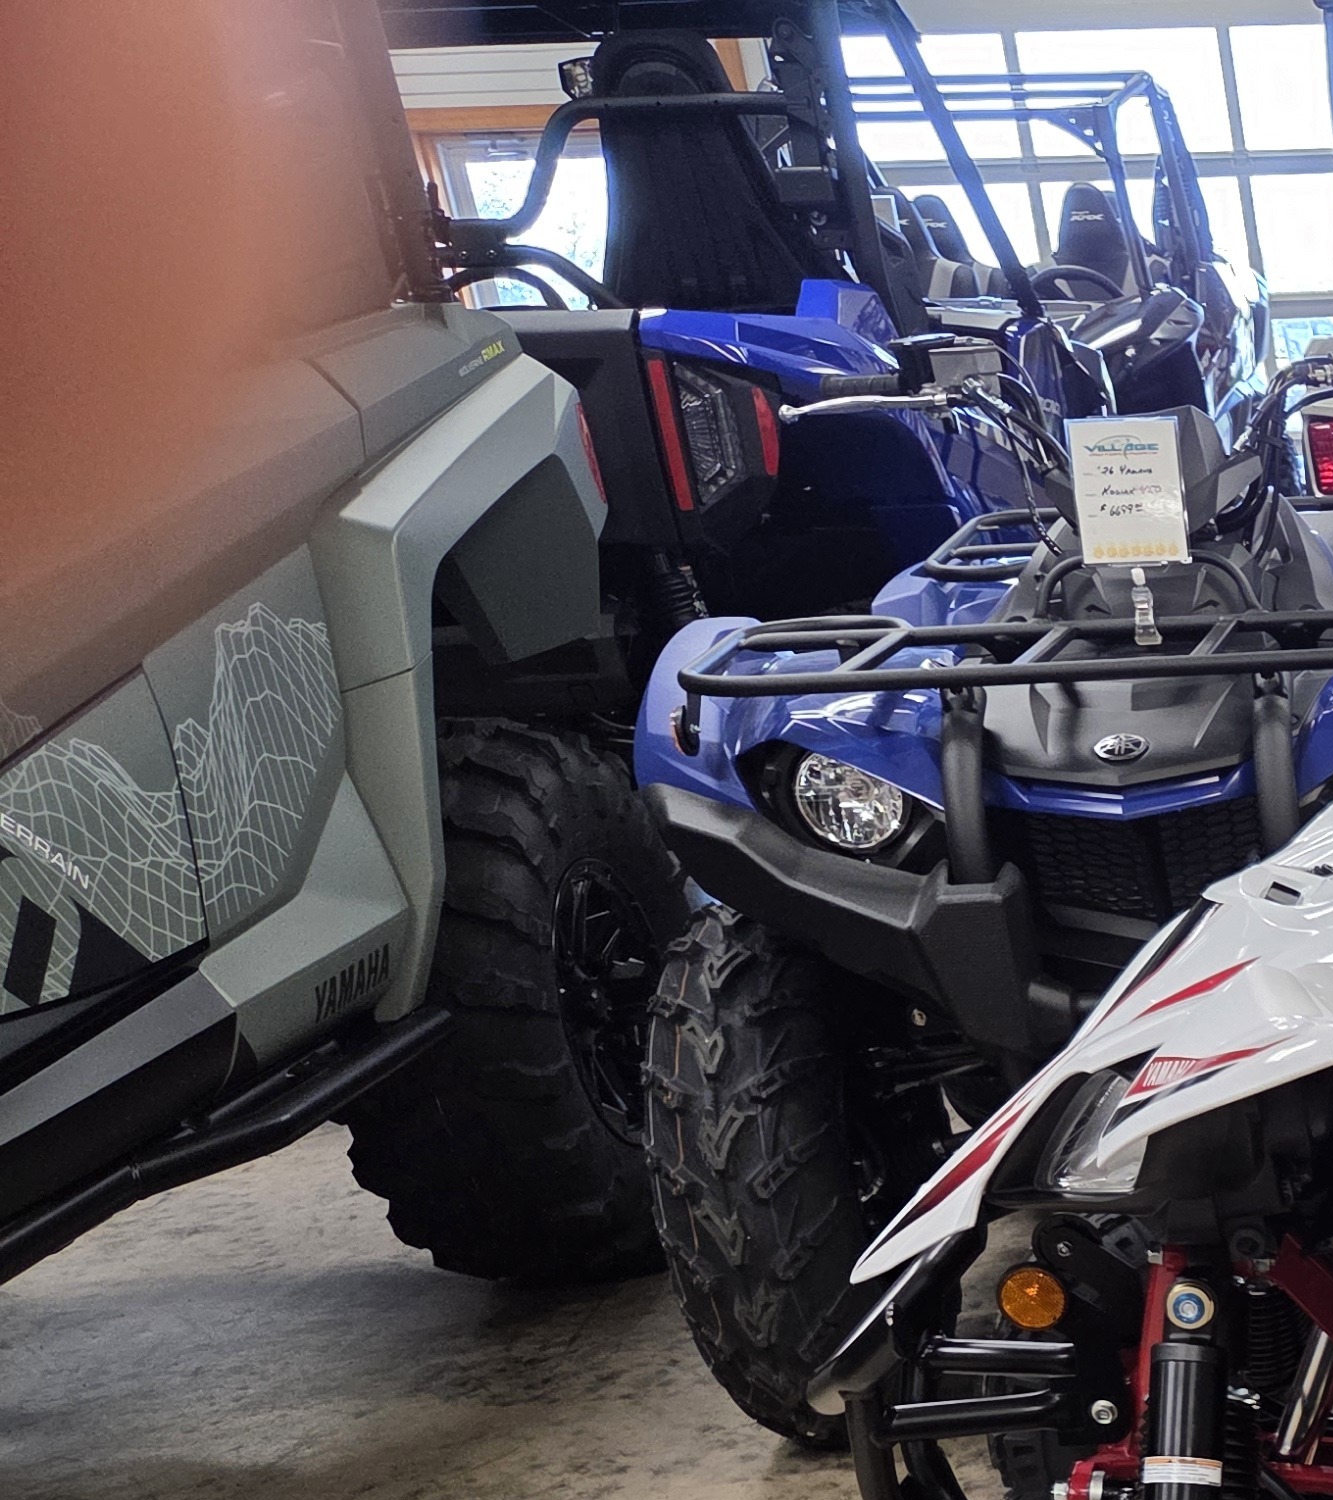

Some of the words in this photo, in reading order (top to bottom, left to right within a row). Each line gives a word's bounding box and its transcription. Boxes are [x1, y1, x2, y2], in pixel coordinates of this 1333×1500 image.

[1083, 443, 1159, 452] VILLAGE
[0, 812, 91, 890] ERRAIN
[314, 943, 390, 1024] YAMAHA
